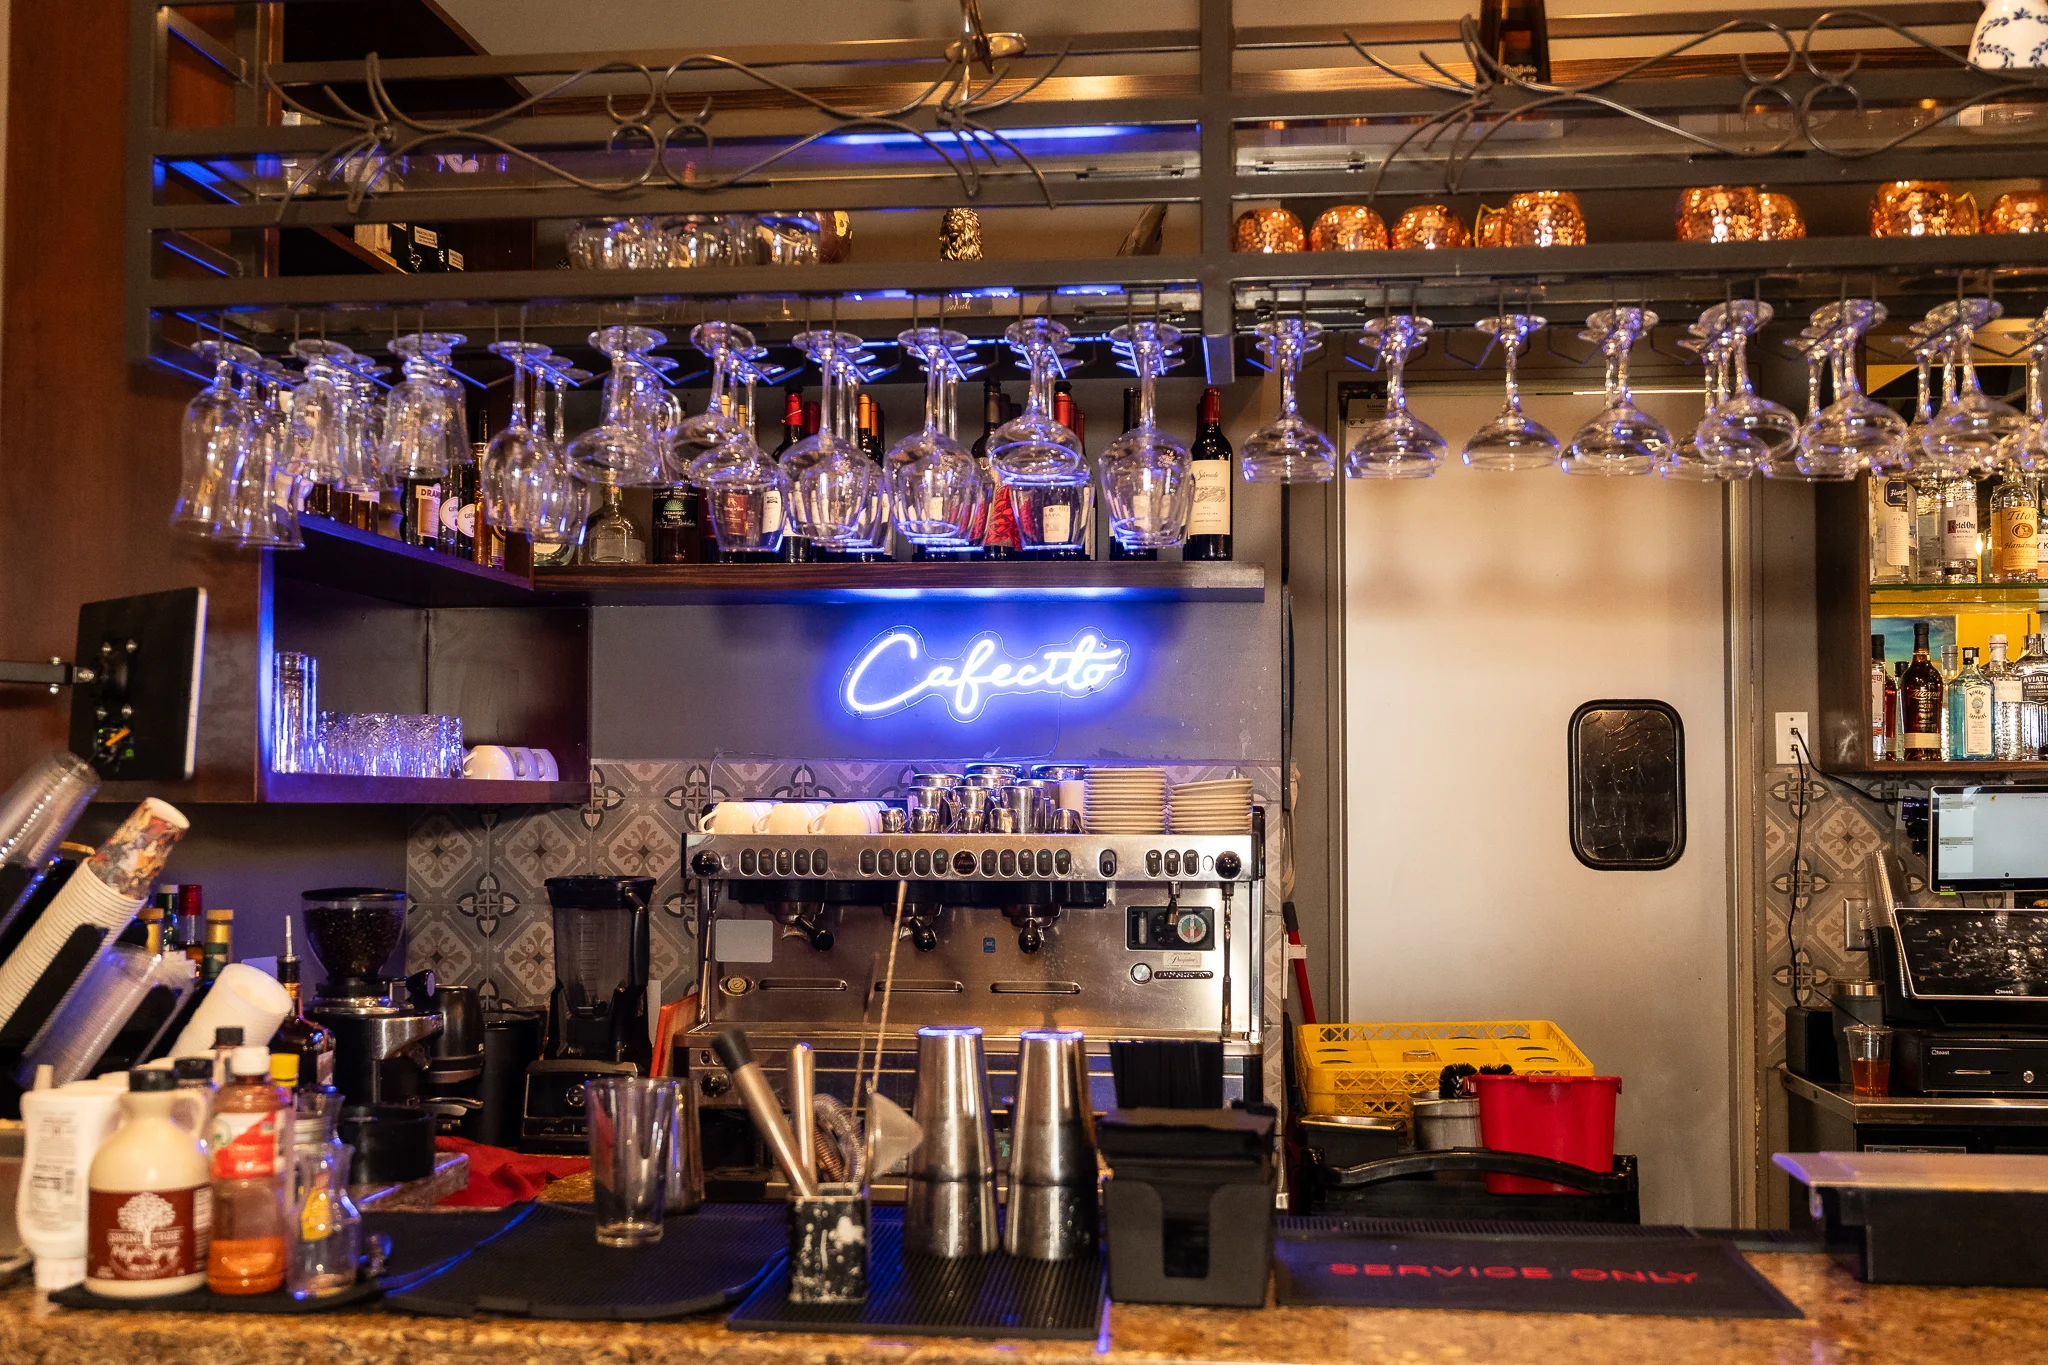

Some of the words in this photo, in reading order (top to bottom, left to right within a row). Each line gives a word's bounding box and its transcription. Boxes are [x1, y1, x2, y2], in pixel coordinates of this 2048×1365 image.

[2007, 510, 2035, 521] Tito's
[847, 633, 1122, 714] Cafecito
[1330, 1263, 1553, 1279] SERVICE
[1571, 1268, 1698, 1284] ONLY
